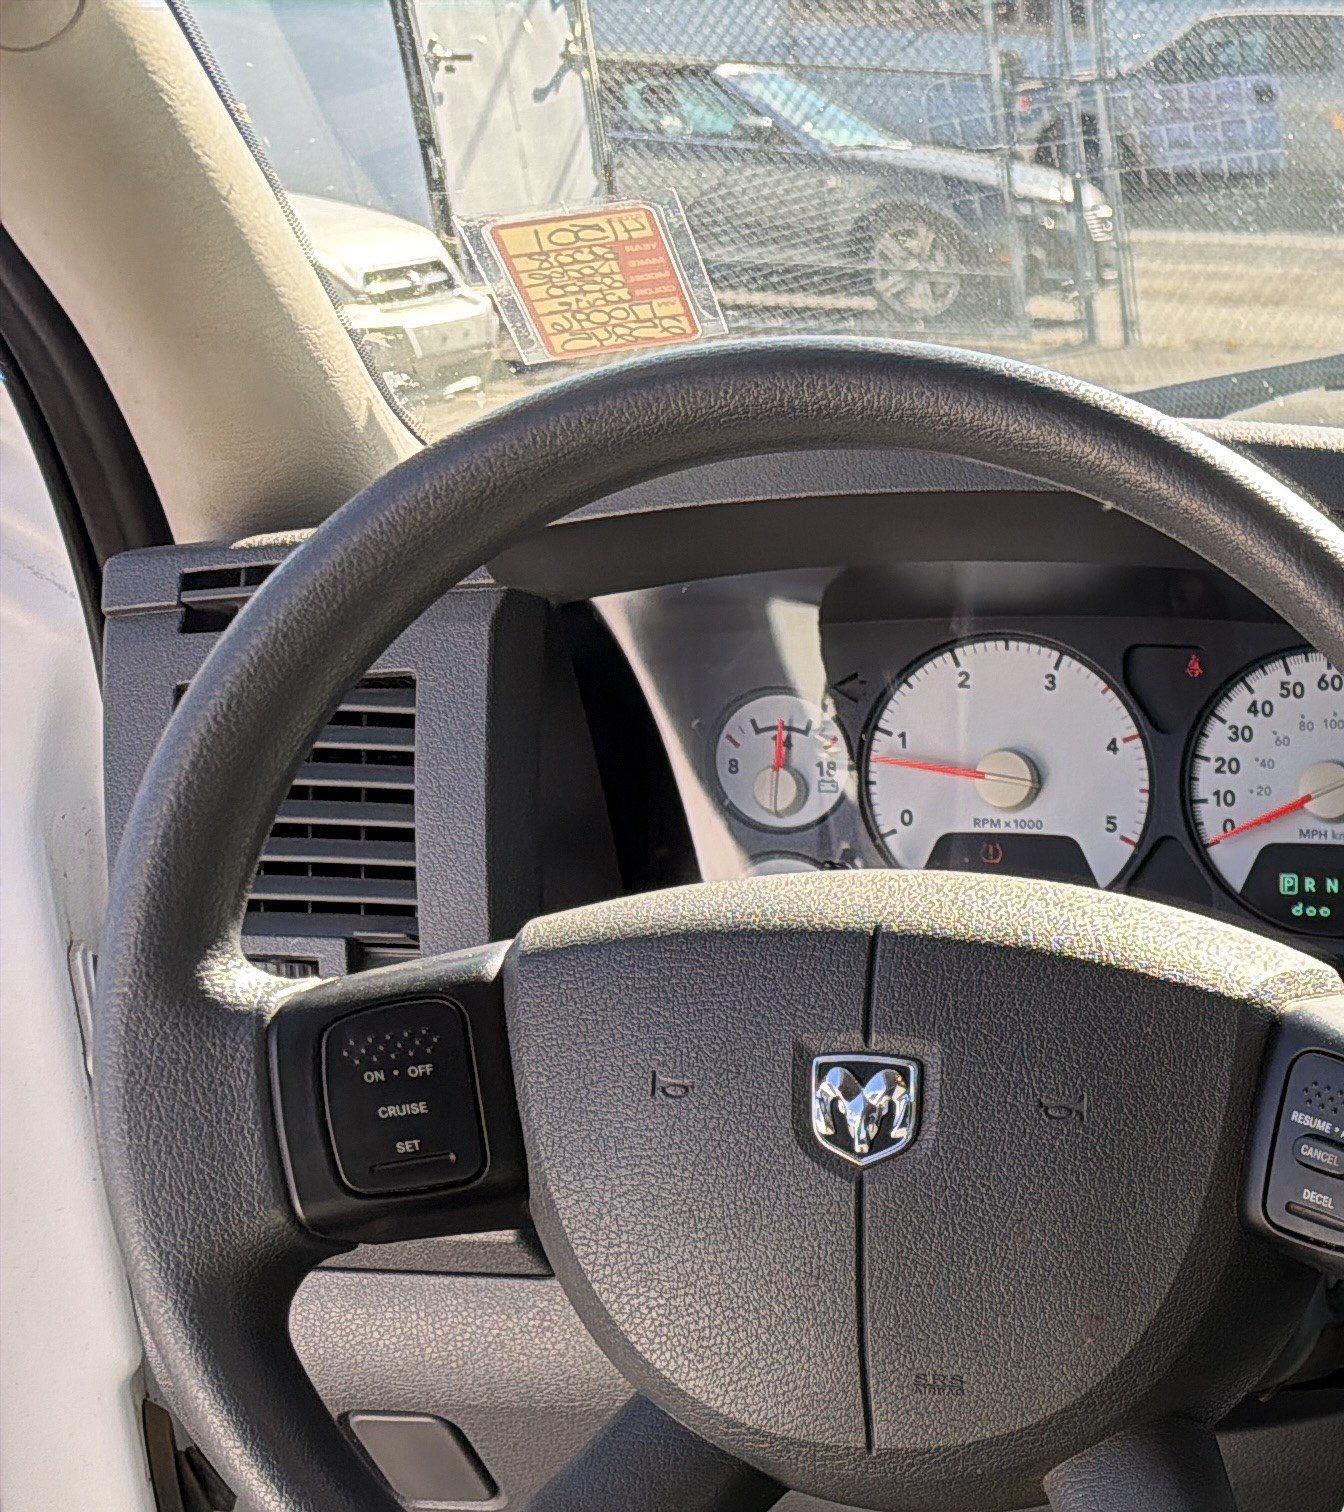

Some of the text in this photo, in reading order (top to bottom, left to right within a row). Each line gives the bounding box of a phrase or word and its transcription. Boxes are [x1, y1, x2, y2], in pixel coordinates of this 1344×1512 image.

[957, 672, 970, 689] 2
[1045, 674, 1057, 691] 3
[1318, 675, 1344, 692] 60
[1279, 681, 1305, 699] 50
[1247, 700, 1274, 718] 40
[1299, 720, 1315, 732] 80
[1324, 718, 1344, 731] 100
[897, 732, 907, 748] 1
[1228, 725, 1253, 742] 30
[1274, 735, 1290, 747] 60
[1106, 738, 1119, 755] 4
[728, 758, 739, 774] 8
[815, 760, 837, 777] 18
[1215, 757, 1241, 775] 20
[1259, 758, 1275, 770] 40
[1212, 790, 1236, 807] 10
[1256, 785, 1272, 797] 20
[900, 809, 913, 827] 0
[973, 817, 1001, 829] RPM
[1105, 816, 1117, 833] 5
[1223, 819, 1235, 836] 0
[1299, 829, 1329, 842] MPH
[1305, 878, 1316, 893] R
[1327, 879, 1339, 894] N
[363, 1063, 434, 1083] ON OFF
[377, 1101, 429, 1119] CRUISE
[1290, 1110, 1333, 1135] RESUME
[395, 1139, 421, 1154] SET
[1300, 1143, 1340, 1167] CANCEL
[1302, 1188, 1335, 1210] DECEL
